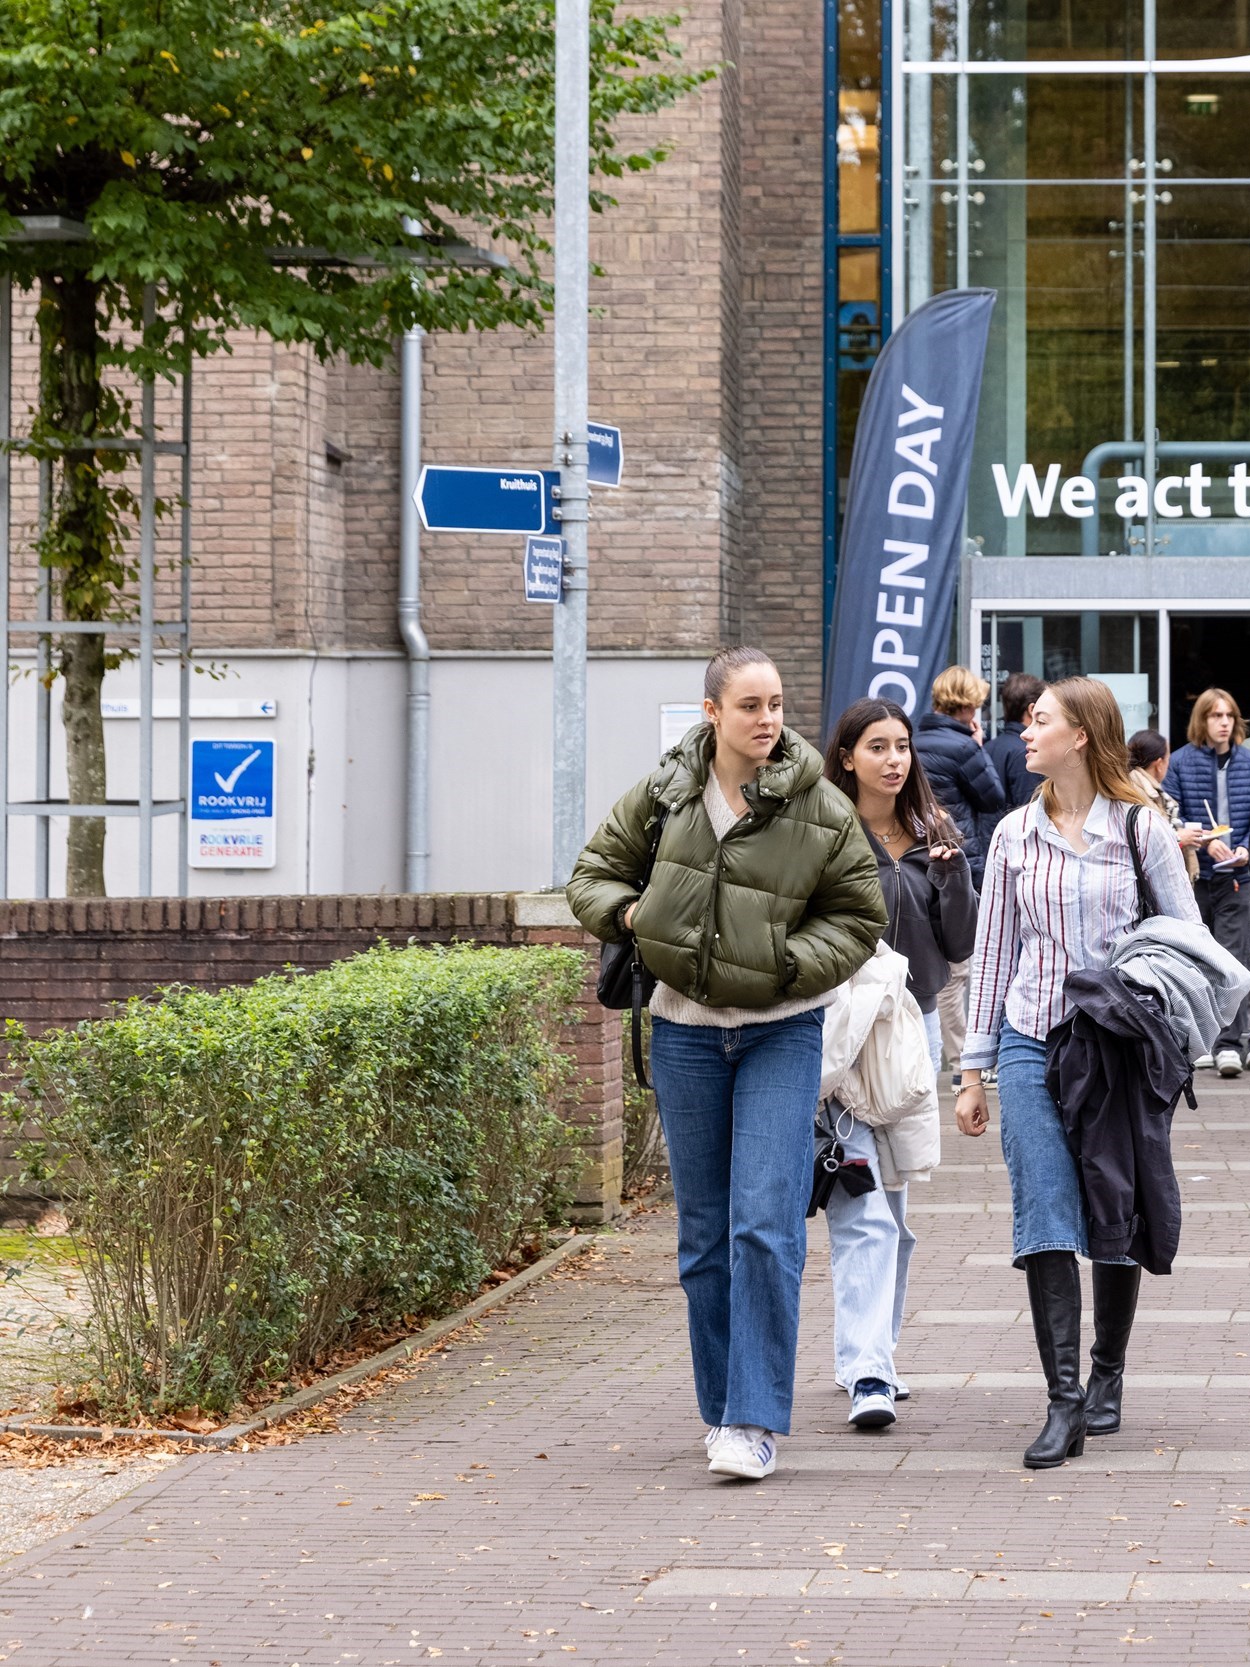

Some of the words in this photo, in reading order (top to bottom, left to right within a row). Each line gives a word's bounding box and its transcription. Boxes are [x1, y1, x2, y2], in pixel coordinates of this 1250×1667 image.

[888, 383, 944, 520] DAY
[500, 478, 538, 491] Kruithuis
[991, 463, 1096, 518] We
[1115, 463, 1211, 518] act
[868, 539, 930, 717] OPEN
[198, 795, 266, 807] ROOKVRIJ
[200, 834, 263, 845] ROOKVRIJE
[200, 846, 263, 857] GENERATIE
